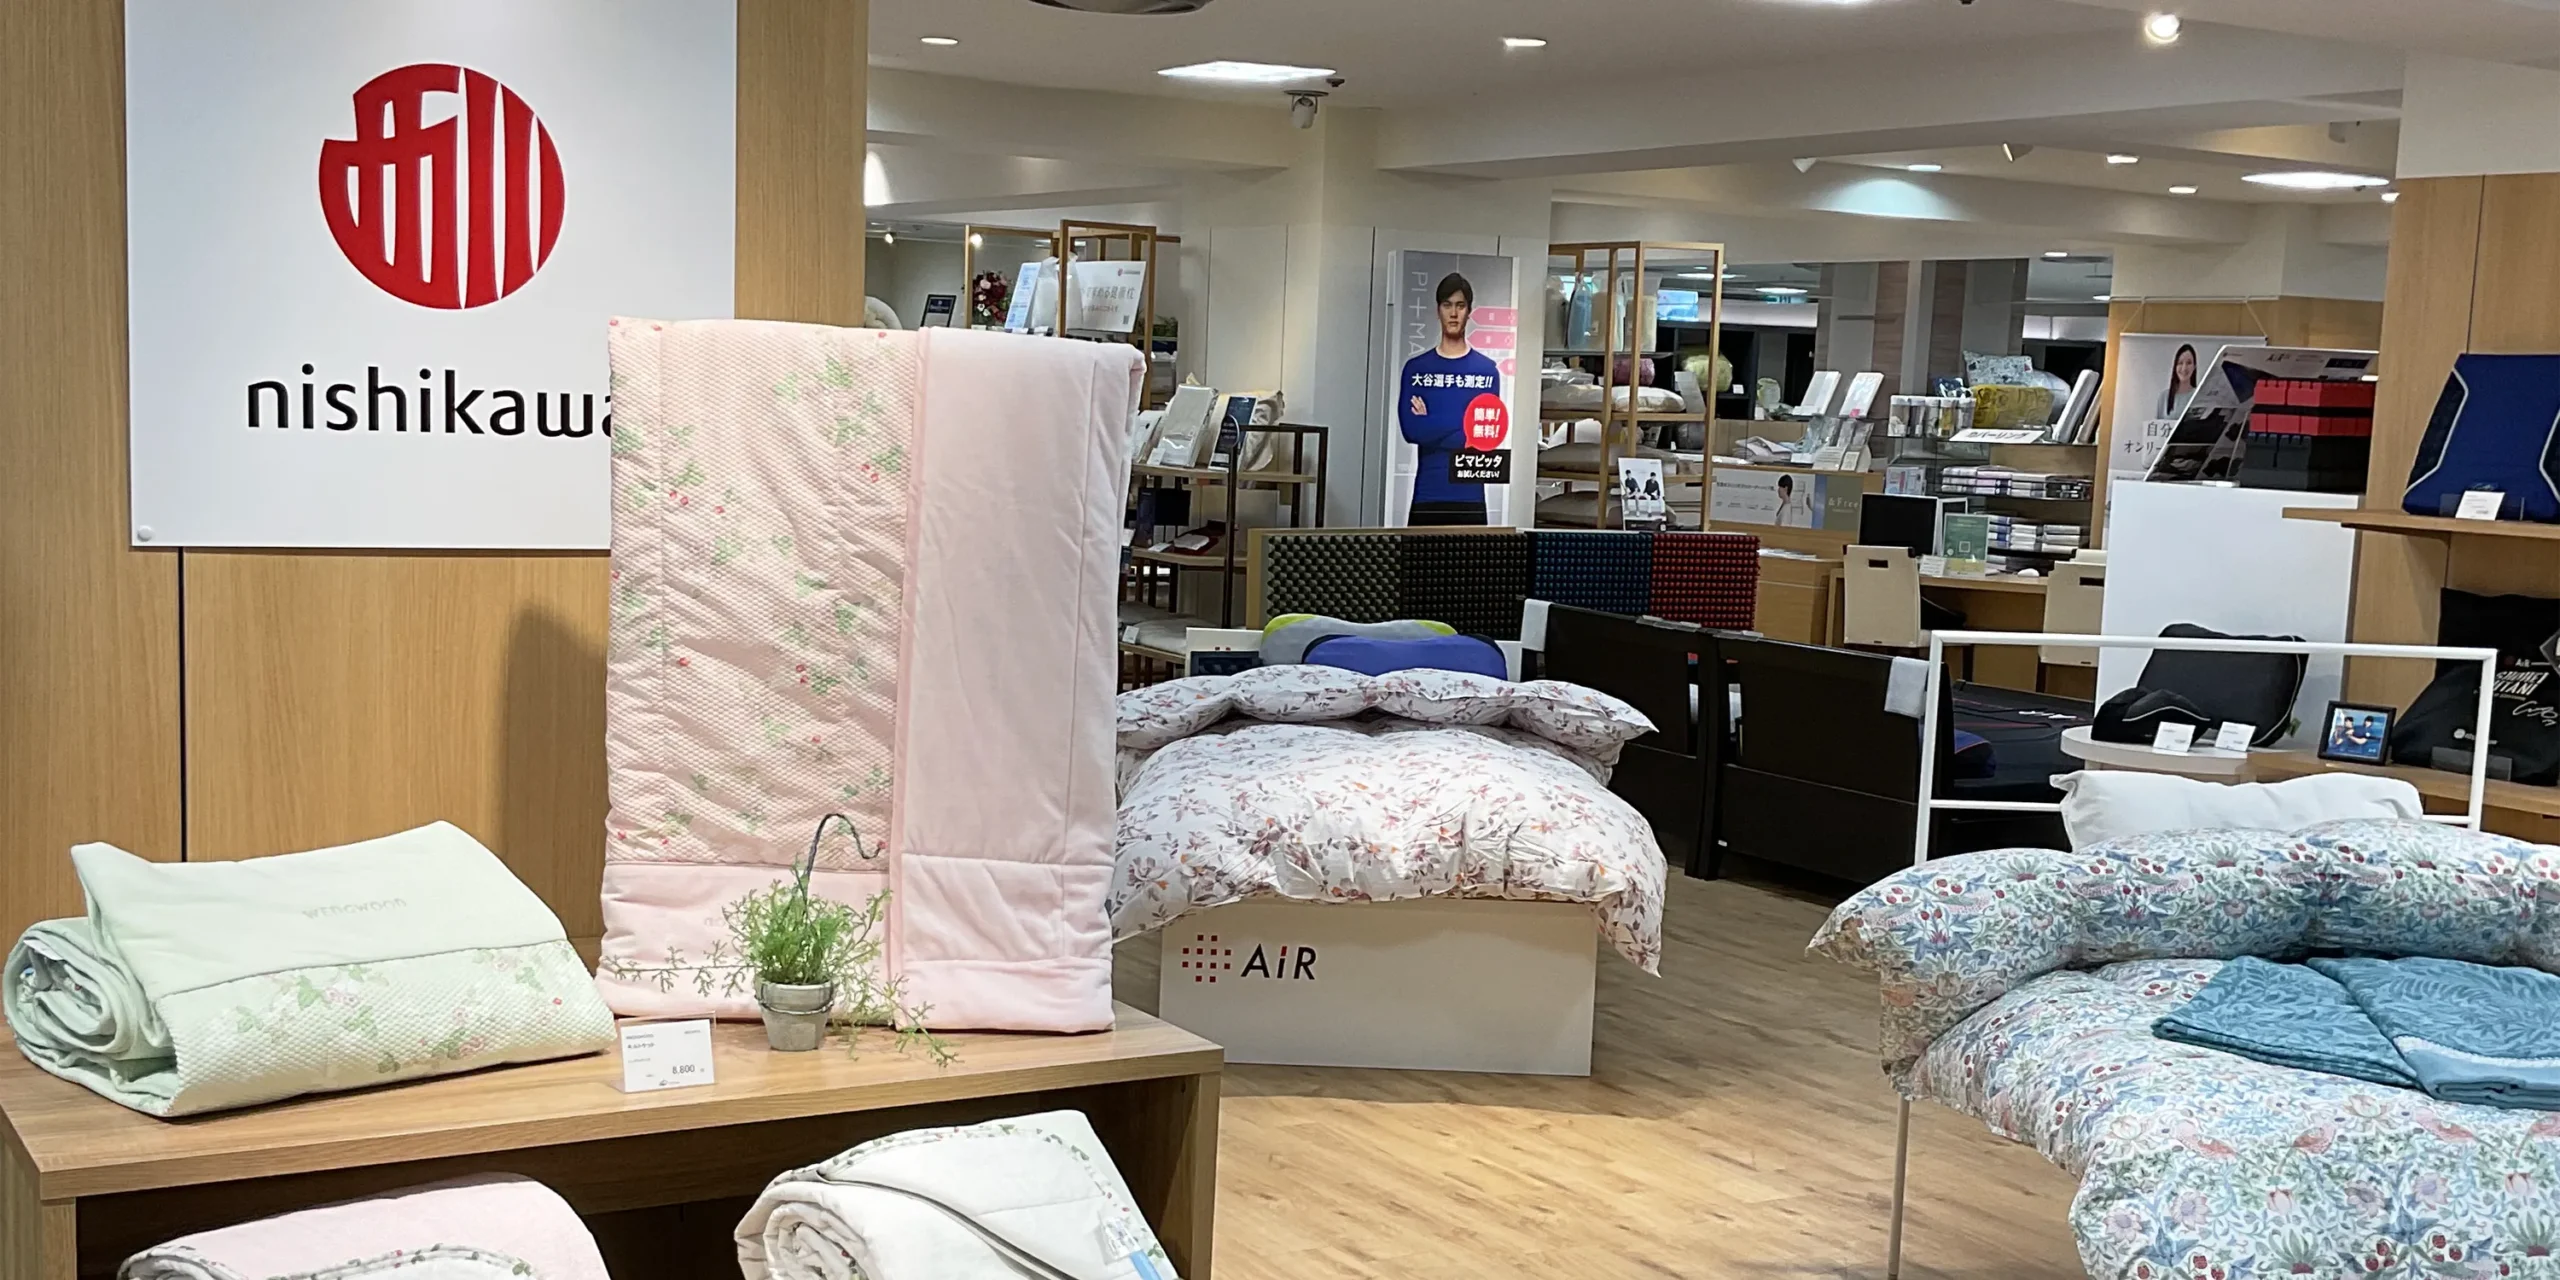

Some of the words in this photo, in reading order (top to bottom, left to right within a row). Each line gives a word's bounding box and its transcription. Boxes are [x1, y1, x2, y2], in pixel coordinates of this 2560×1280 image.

[1411, 373, 1494, 389] 大谷選手も測定!!
[1474, 407, 1501, 421] 簡単!
[1472, 424, 1500, 438] 無料!
[302, 898, 407, 919] WEDGWOOD
[1240, 943, 1317, 980] AiR
[672, 1064, 696, 1075] 8,800
